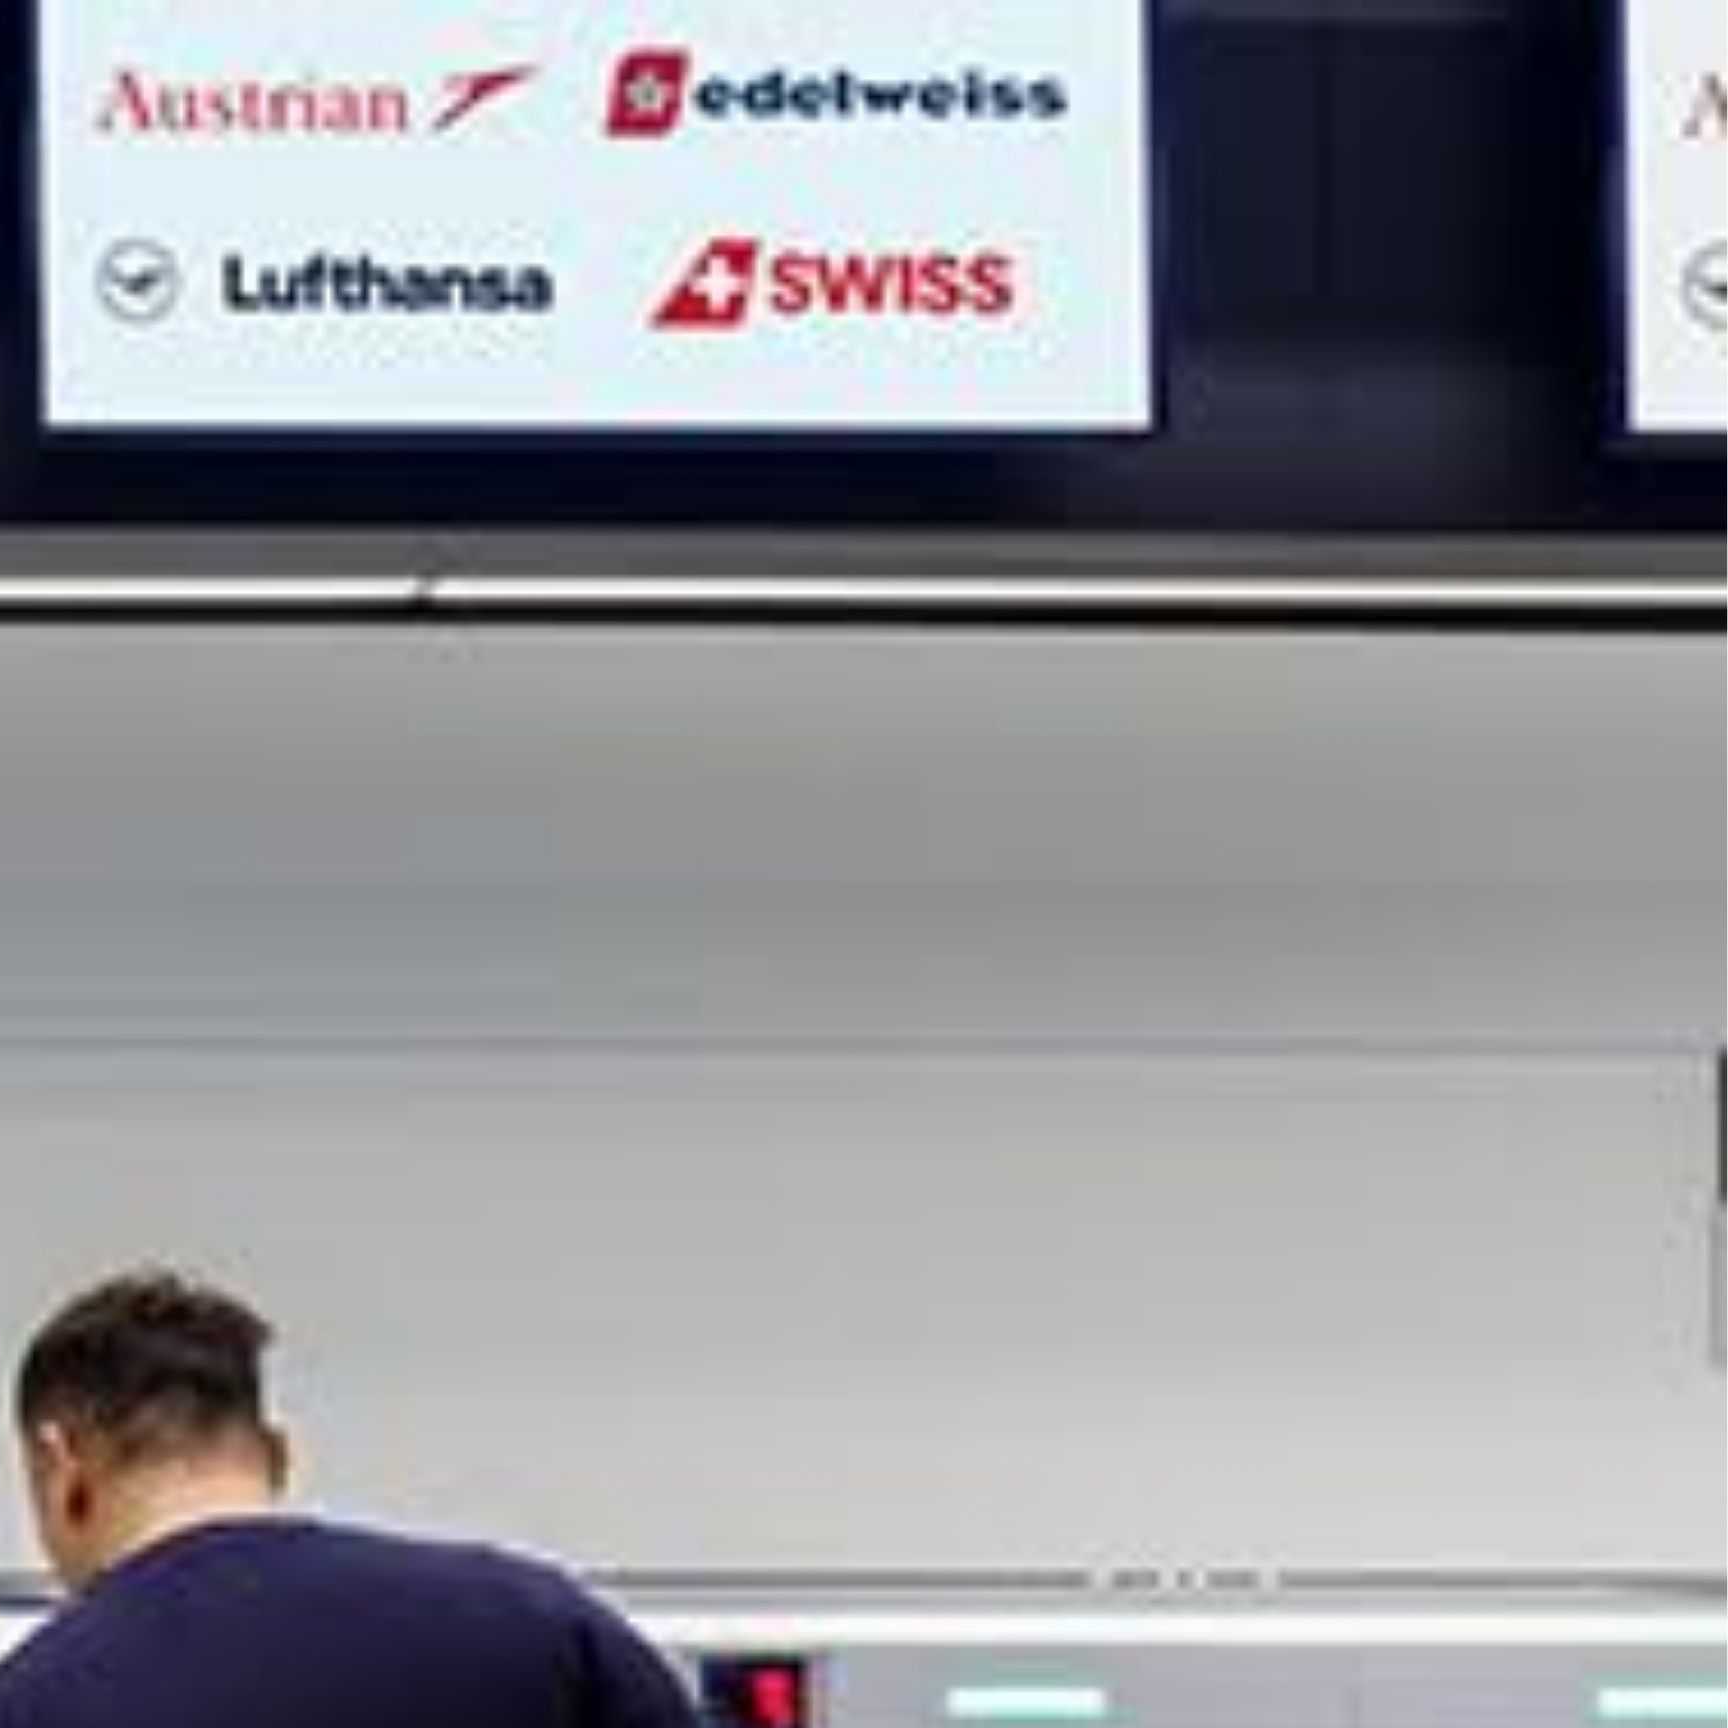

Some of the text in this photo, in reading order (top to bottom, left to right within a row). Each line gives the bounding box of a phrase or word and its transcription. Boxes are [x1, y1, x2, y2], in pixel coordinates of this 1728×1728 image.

[96, 67, 410, 134] Austrian
[694, 65, 1070, 120] edelweiss
[220, 250, 555, 314] Lufthansa
[769, 250, 1015, 316] SWISS
